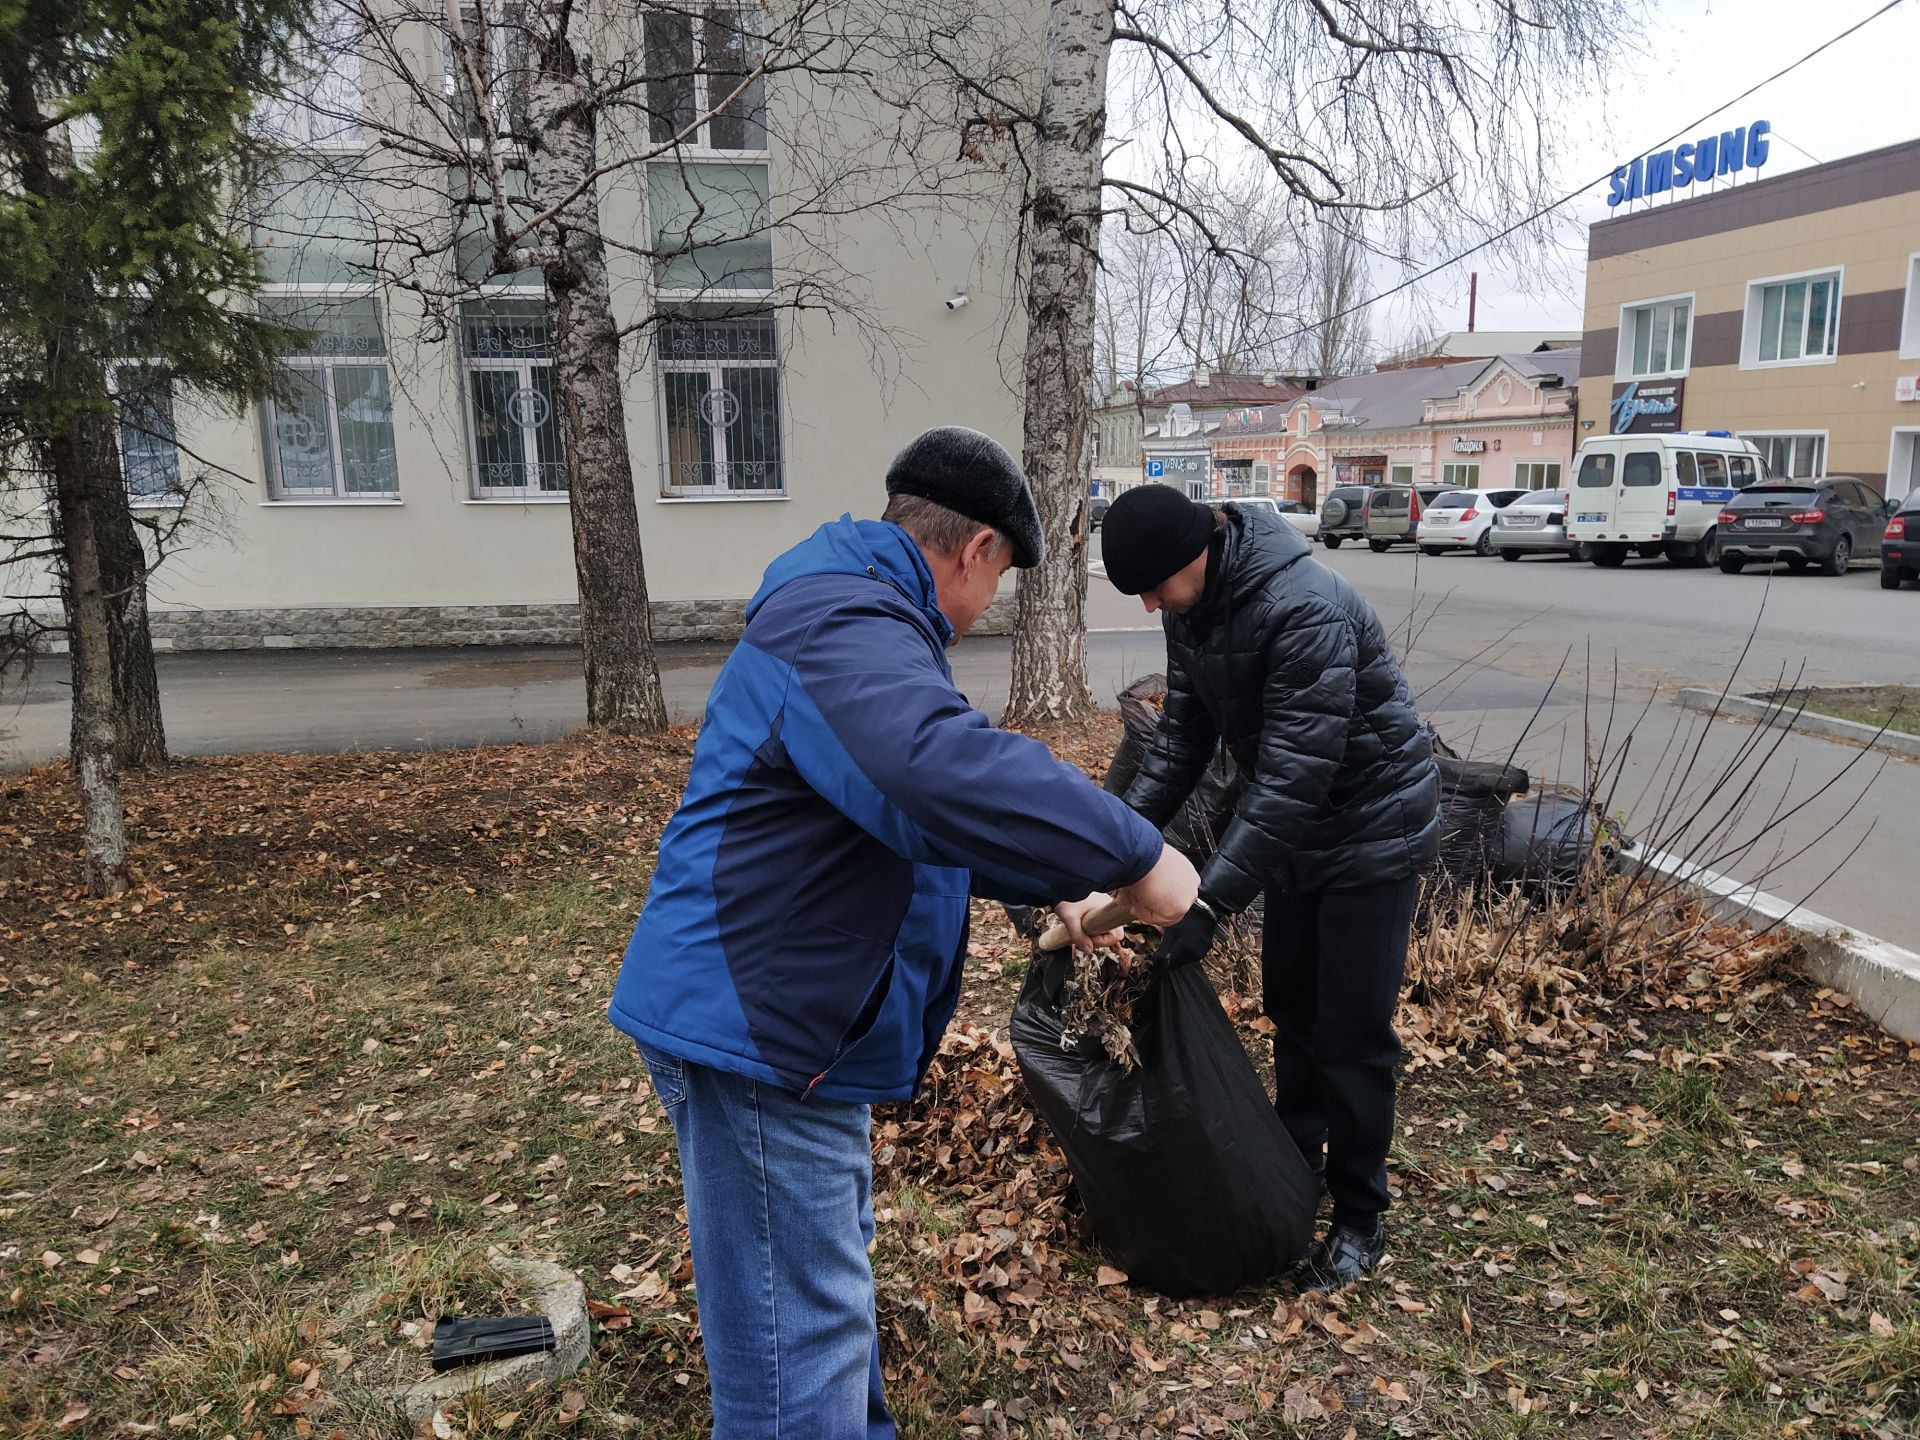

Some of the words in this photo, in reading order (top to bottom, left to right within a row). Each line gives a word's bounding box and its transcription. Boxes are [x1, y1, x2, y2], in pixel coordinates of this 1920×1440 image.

[1607, 120, 1771, 207] SAMSUNG
[1452, 437, 1485, 455] Пекарня
[1152, 462, 1161, 475] P
